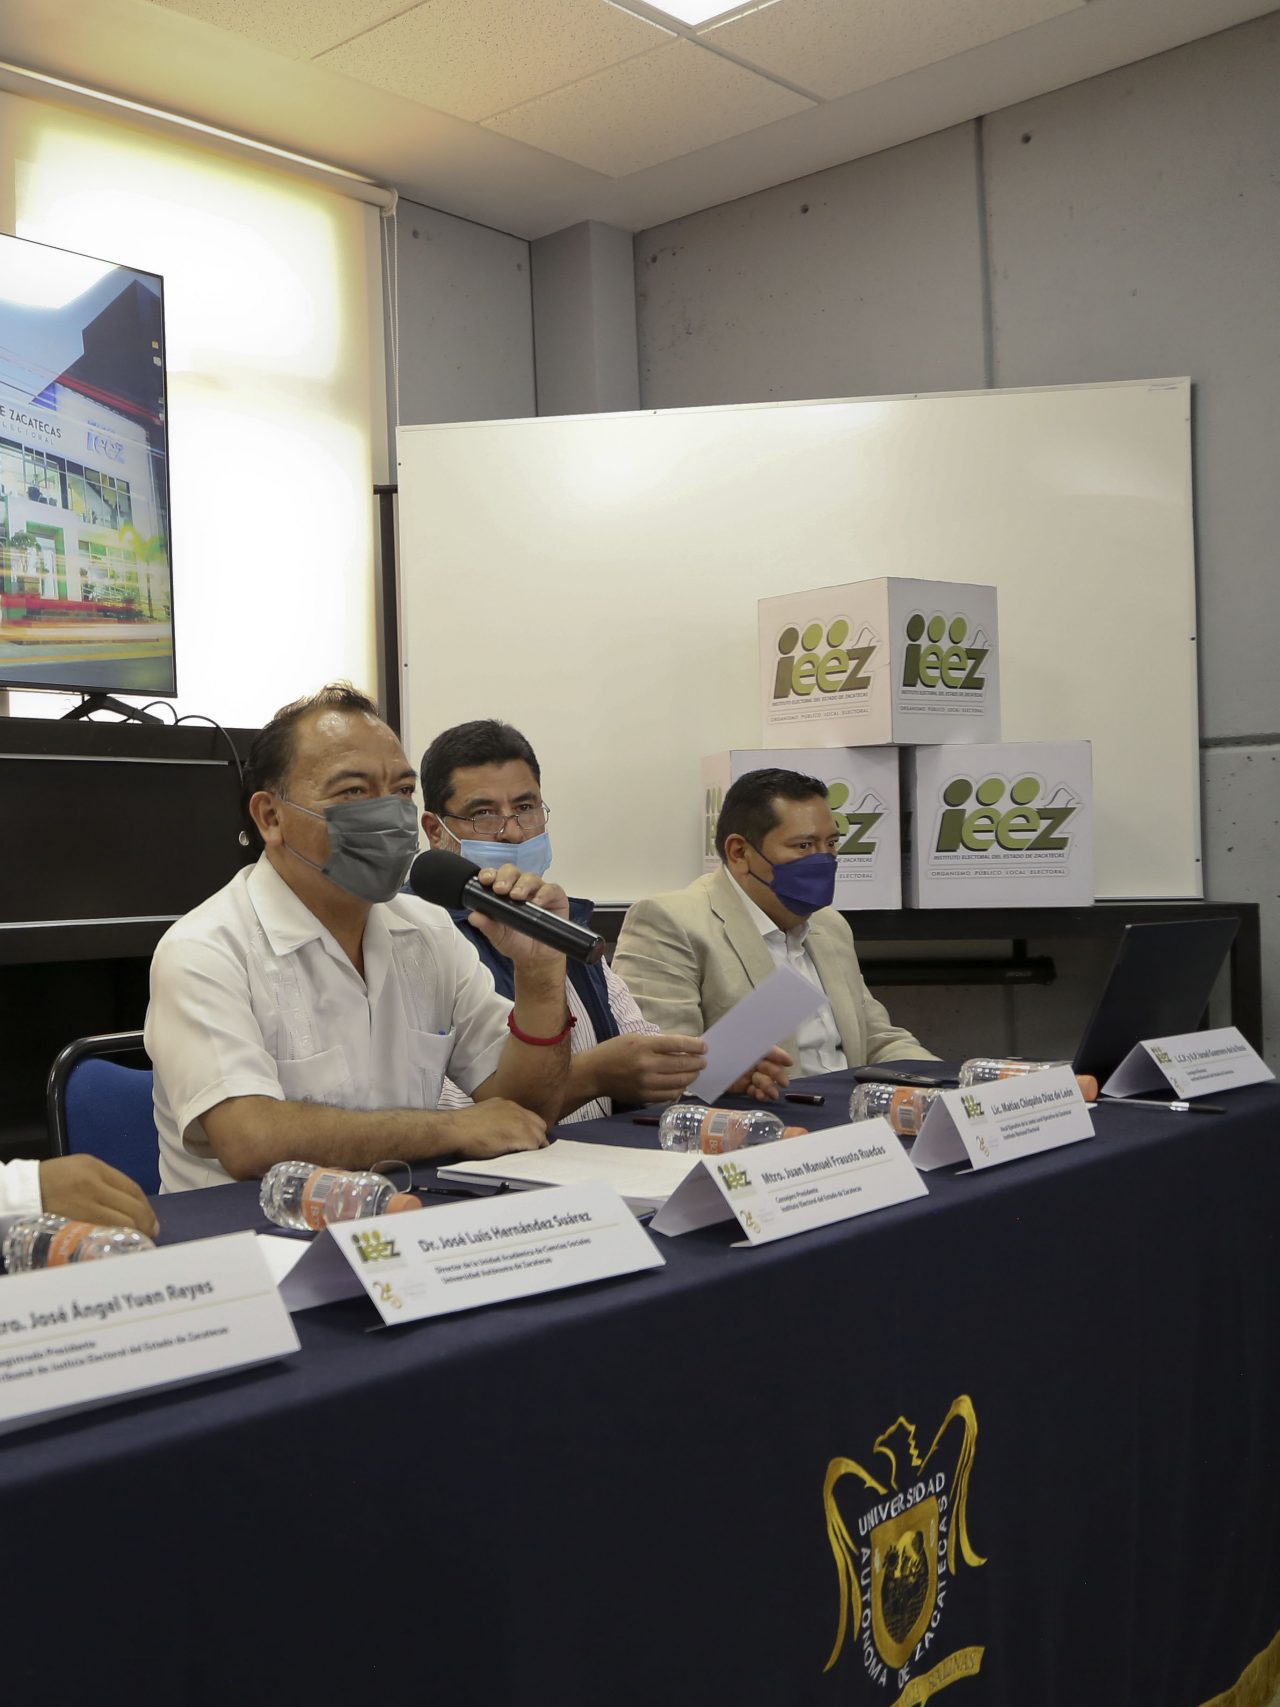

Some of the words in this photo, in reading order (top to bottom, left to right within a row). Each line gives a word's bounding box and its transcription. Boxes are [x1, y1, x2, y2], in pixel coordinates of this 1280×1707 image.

[8, 408, 62, 439] ZACATECAS
[773, 619, 877, 700] ieez
[902, 614, 990, 690] ieez
[935, 777, 1076, 853] ieez
[991, 1105, 1002, 1114] Lic.
[1053, 1090, 1060, 1099] de
[761, 1169, 785, 1183] Mtro.
[782, 1165, 804, 1178] Juan
[801, 1157, 832, 1173] Manuel
[830, 1151, 859, 1166] Frausto
[857, 1144, 886, 1159] Ruedas
[416, 1238, 439, 1252] Dr.
[435, 1232, 467, 1248] José
[488, 1217, 555, 1238] Hernández
[550, 1209, 593, 1226] Suárez
[27, 1305, 67, 1328] José
[67, 1293, 123, 1323] Ángel
[121, 1288, 165, 1309] Yuen
[165, 1278, 214, 1303] Reyes
[858, 1472, 945, 1536] UNIVERSIDAD
[898, 1662, 911, 1689] DE
[914, 1495, 948, 1661] ZACATECAS
